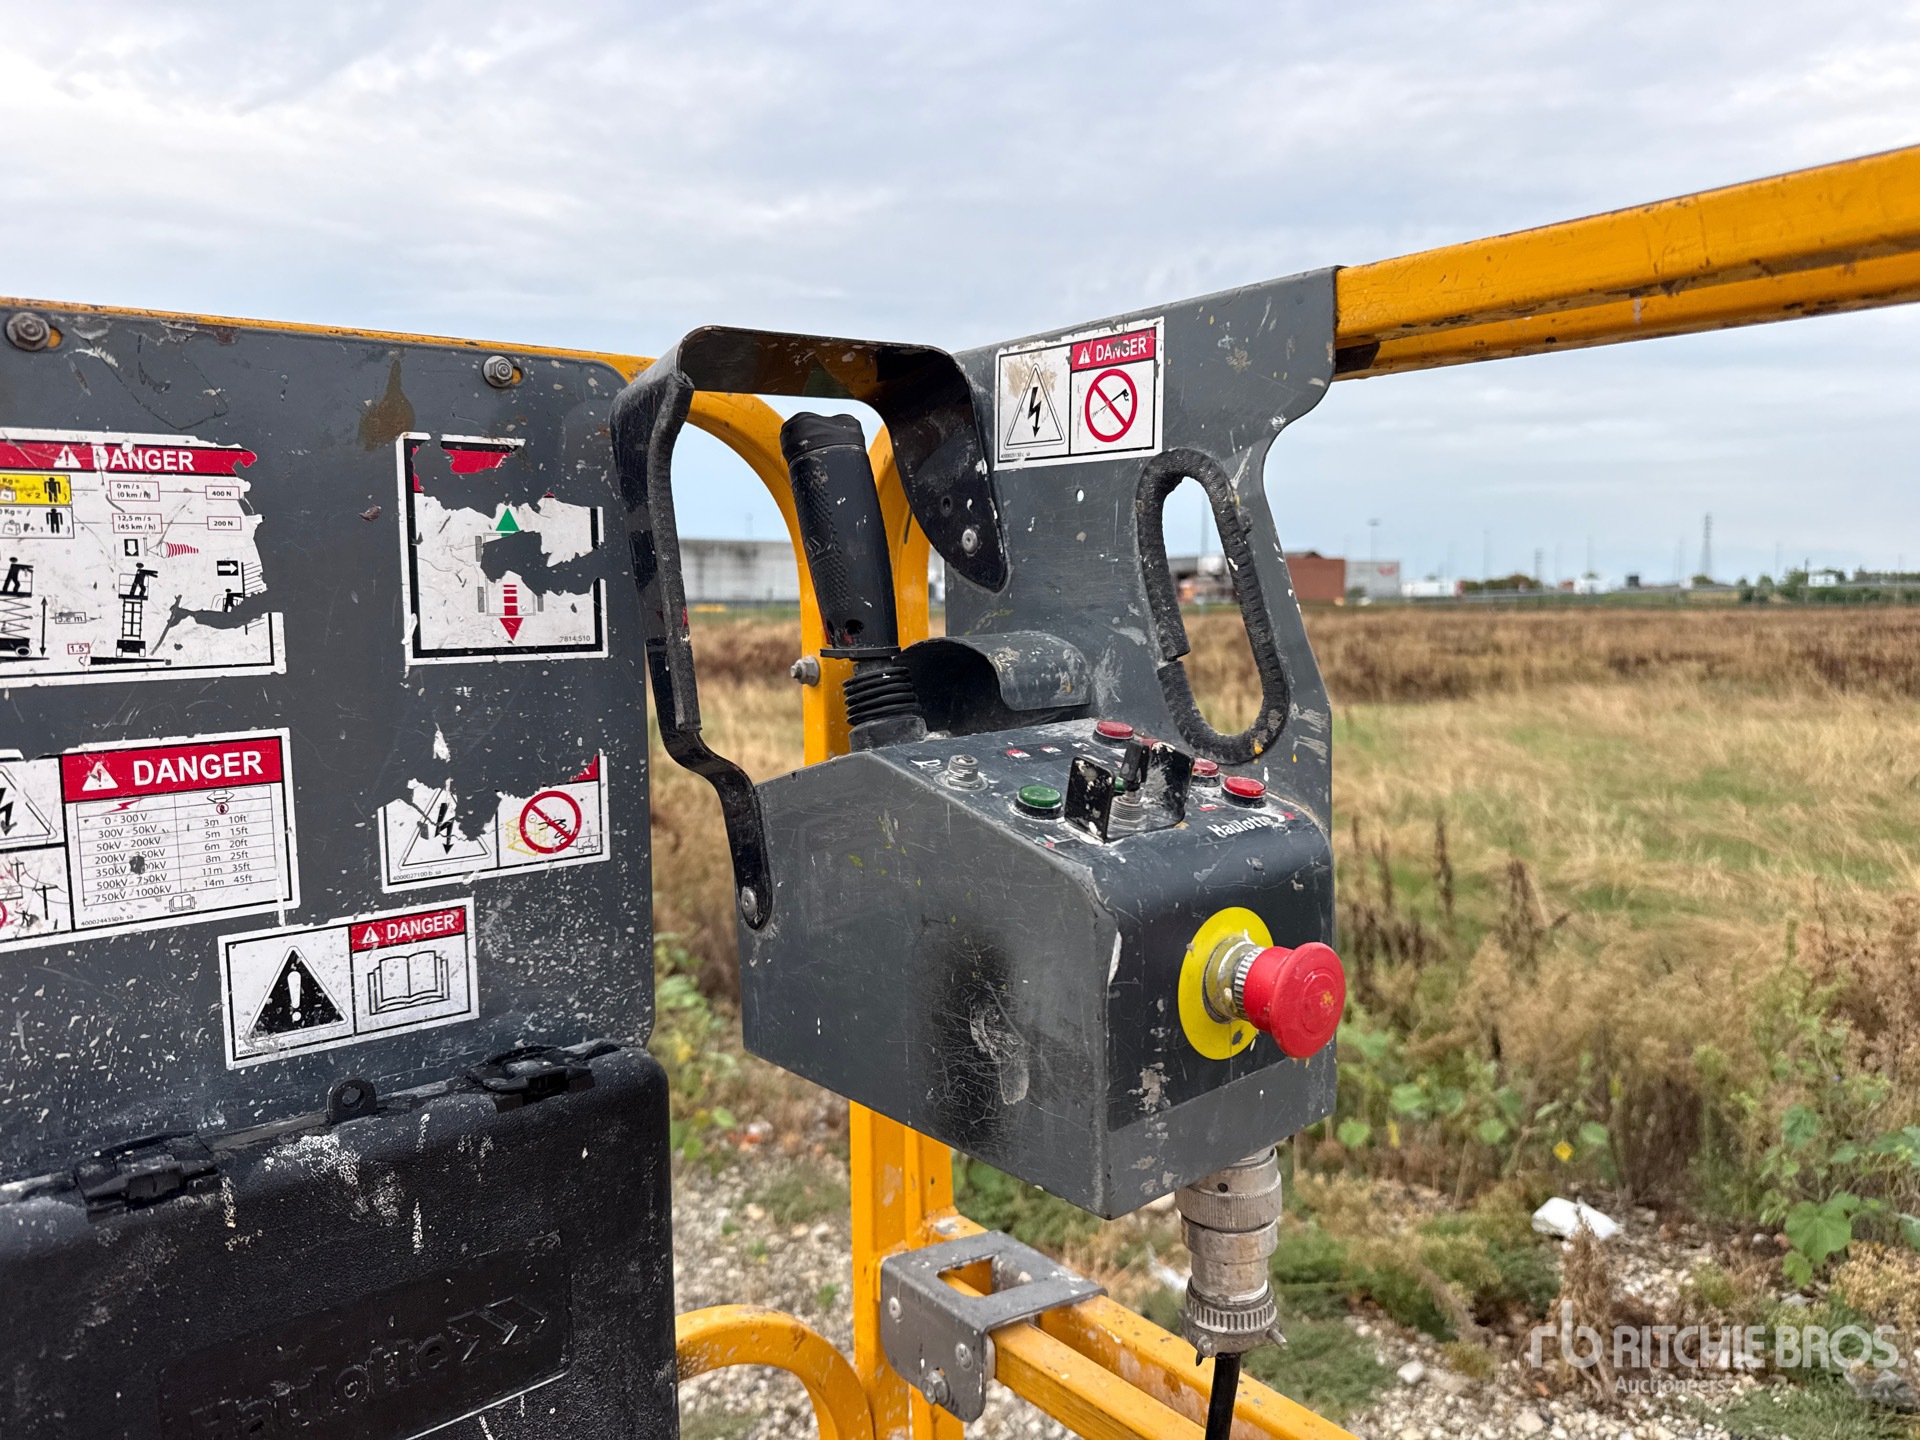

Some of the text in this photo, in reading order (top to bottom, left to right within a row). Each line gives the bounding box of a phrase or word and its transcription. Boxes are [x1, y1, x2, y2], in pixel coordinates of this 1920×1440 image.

[1096, 337, 1147, 361] DANGER
[93, 445, 195, 471] DANGER
[132, 750, 264, 786] DANGER
[104, 816, 111, 825] 0
[120, 814, 139, 824] 300
[140, 813, 148, 821] V
[204, 814, 247, 827] 3m 10ft
[98, 828, 124, 839] 300V
[132, 824, 157, 835] 50kV
[205, 826, 248, 839] 5m 15ft
[96, 841, 121, 852] 50kV
[131, 837, 161, 848] 200kV
[204, 838, 248, 851] 6m 20ft
[95, 853, 126, 865] 200kV
[205, 850, 248, 863] 8m 25ft
[96, 866, 127, 877] 350kV
[202, 862, 250, 876] 11m 35ft
[97, 878, 128, 890] 500kV
[137, 873, 167, 885] 750kV
[204, 873, 252, 887] 14m 45ft
[95, 891, 126, 903] 750kV
[136, 885, 172, 897] 1000kV
[387, 914, 456, 939] DANGER
